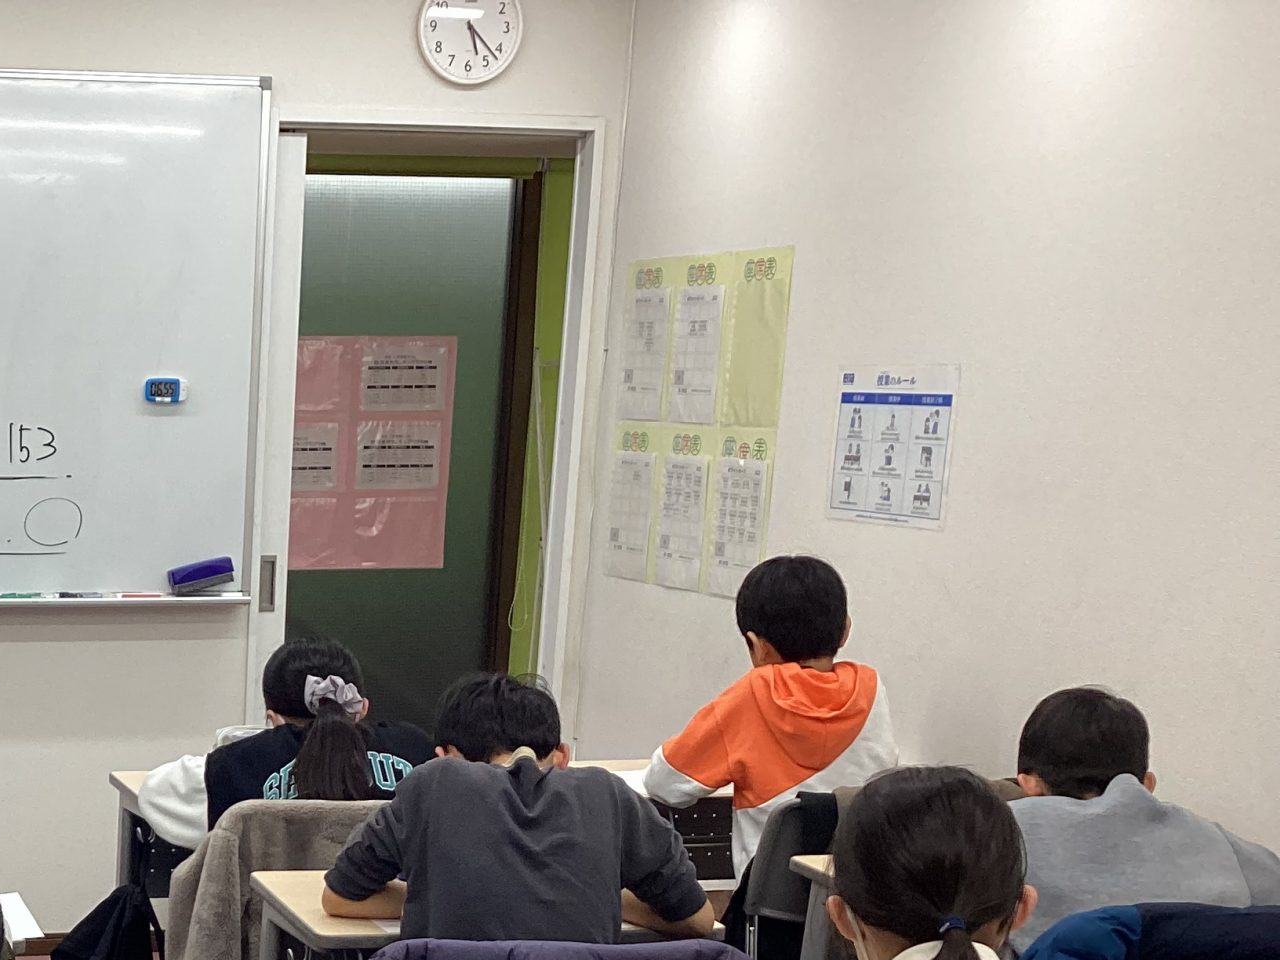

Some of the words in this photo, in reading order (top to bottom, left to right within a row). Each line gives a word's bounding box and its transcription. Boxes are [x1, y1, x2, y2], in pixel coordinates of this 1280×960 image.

[498, 2, 506, 15] 2
[429, 20, 437, 33] 9
[503, 21, 510, 34] 3
[435, 41, 443, 53] 8
[495, 42, 503, 54] 4
[448, 54, 456, 67] 7
[464, 59, 472, 72] 6
[482, 55, 490, 68] 5
[8, 422, 58, 464] 153
